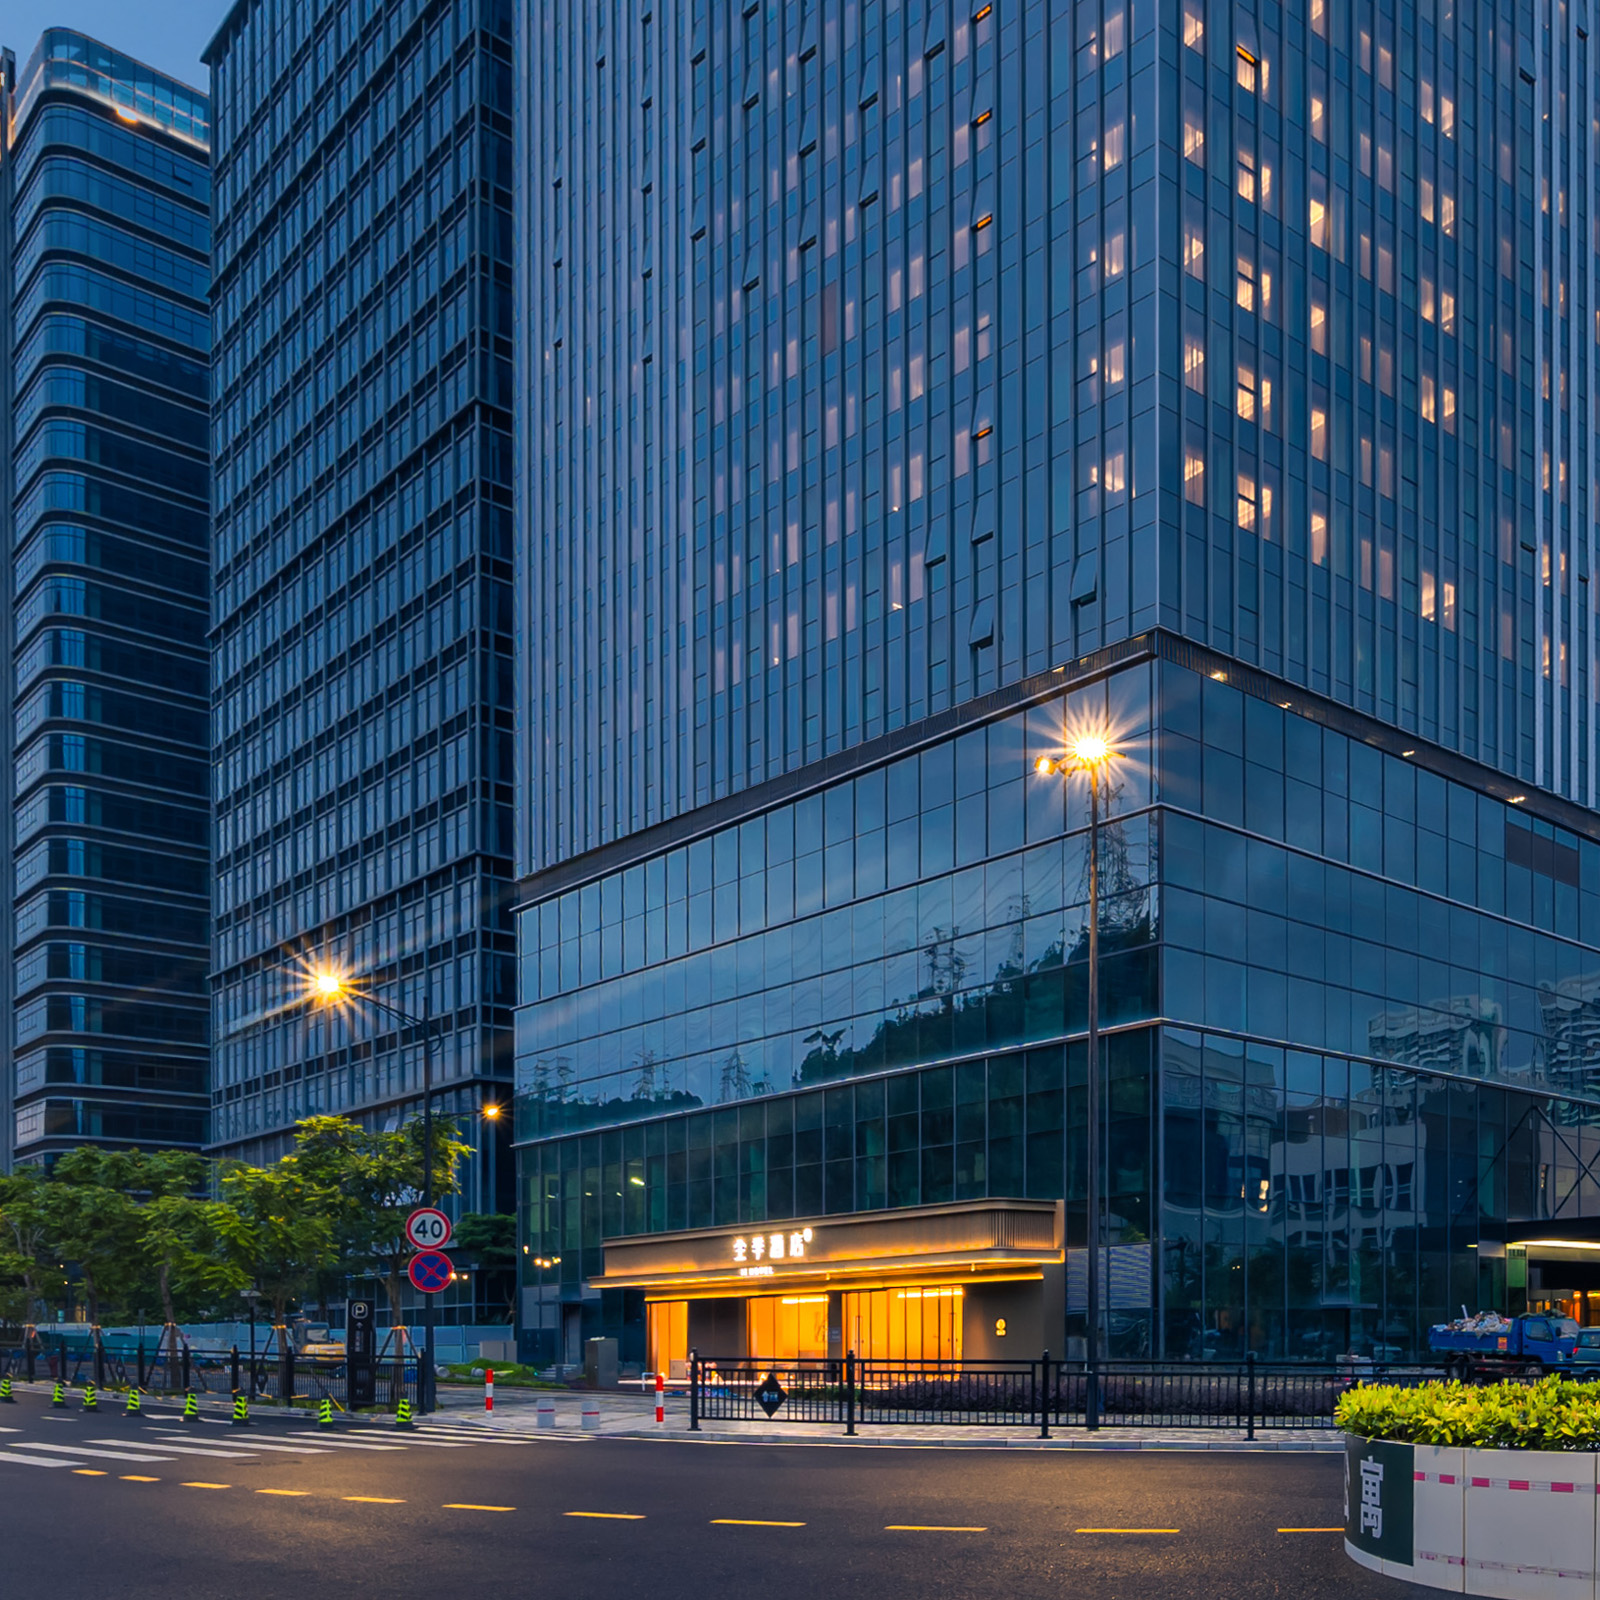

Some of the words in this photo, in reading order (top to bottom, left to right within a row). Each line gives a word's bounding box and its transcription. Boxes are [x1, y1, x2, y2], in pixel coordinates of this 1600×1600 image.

[414, 1219, 443, 1239] 40
[733, 1232, 804, 1261] 全季酒店
